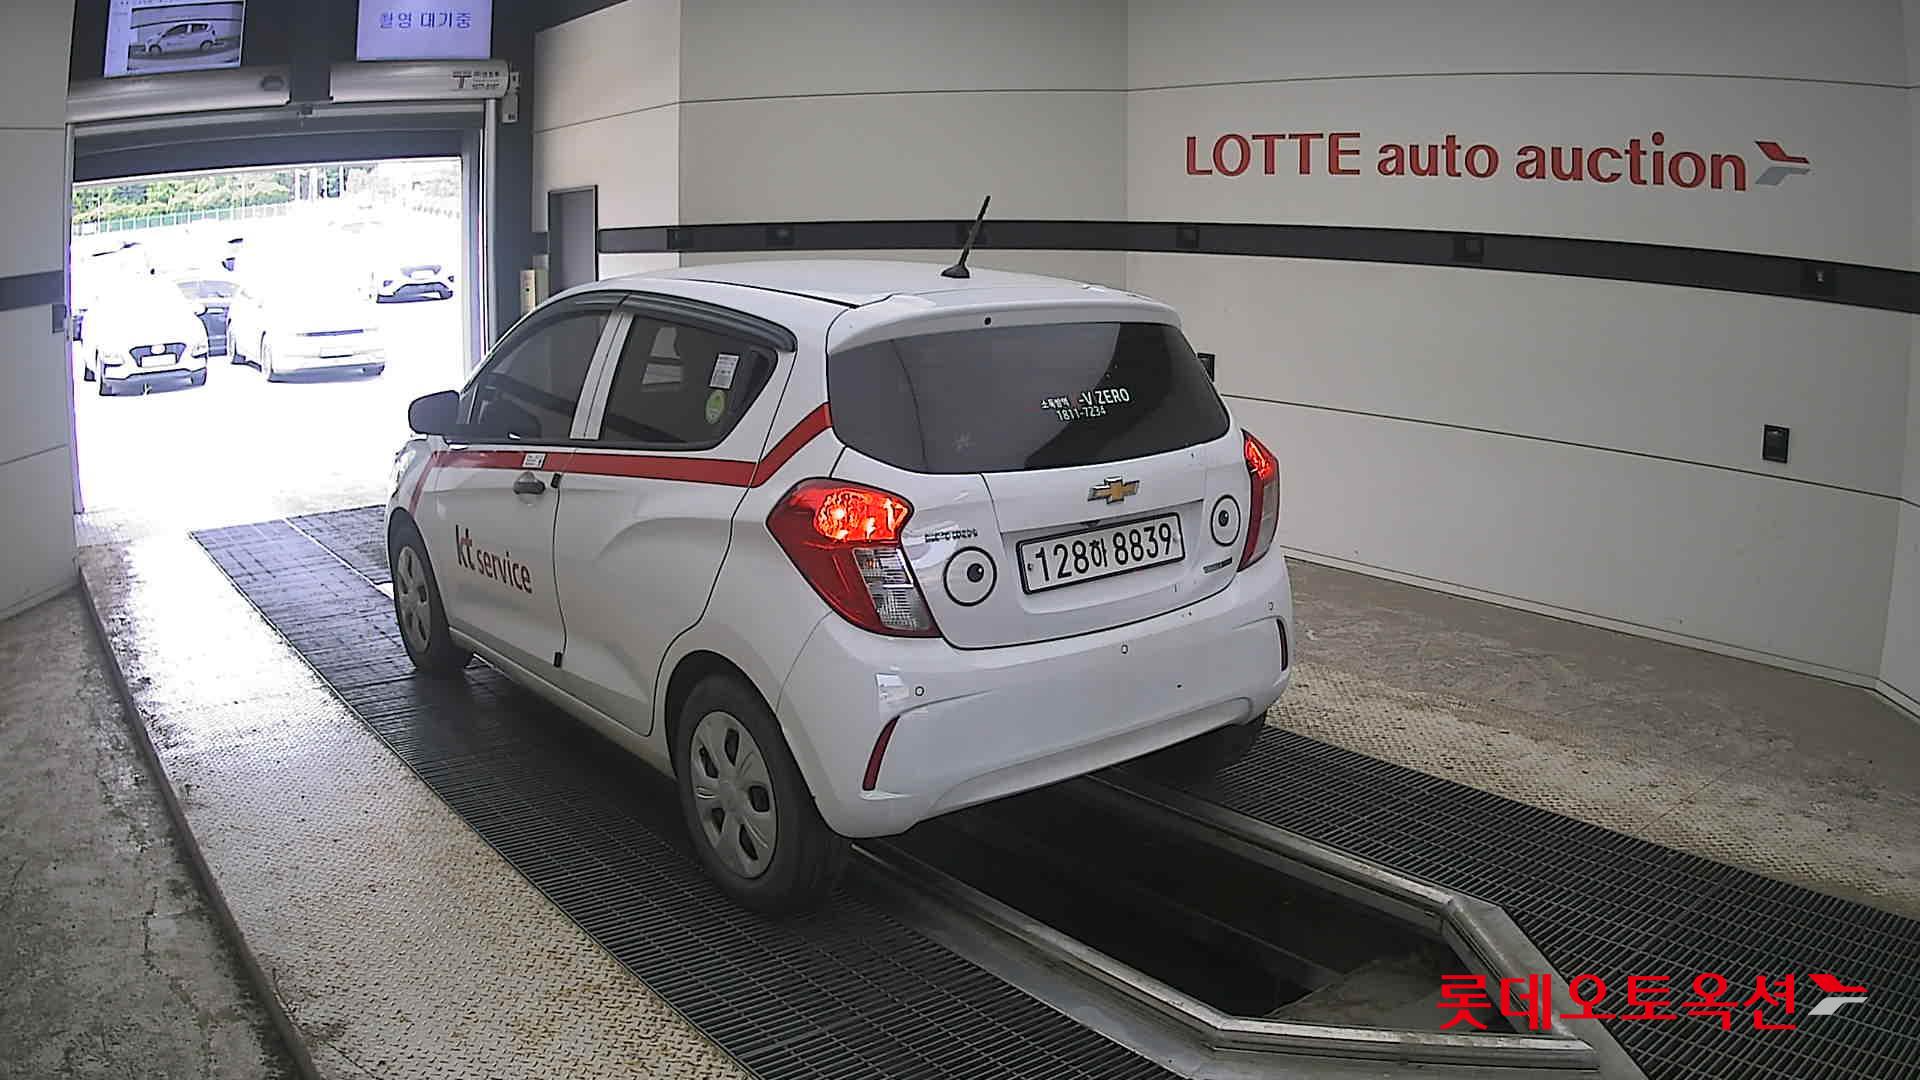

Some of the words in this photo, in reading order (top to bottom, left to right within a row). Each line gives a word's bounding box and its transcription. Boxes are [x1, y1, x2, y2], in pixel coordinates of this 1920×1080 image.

[420, 11, 472, 29] 대기중
[1186, 132, 1362, 176] LOTTE
[1377, 135, 1499, 178] auto
[1515, 131, 1747, 191] auction
[1056, 404, 1106, 421] 1811-7234
[1095, 387, 1131, 405] ZERO
[455, 524, 476, 571] kt
[476, 548, 533, 594] service
[1035, 537, 1108, 582] 128하
[1112, 522, 1172, 566] 8839
